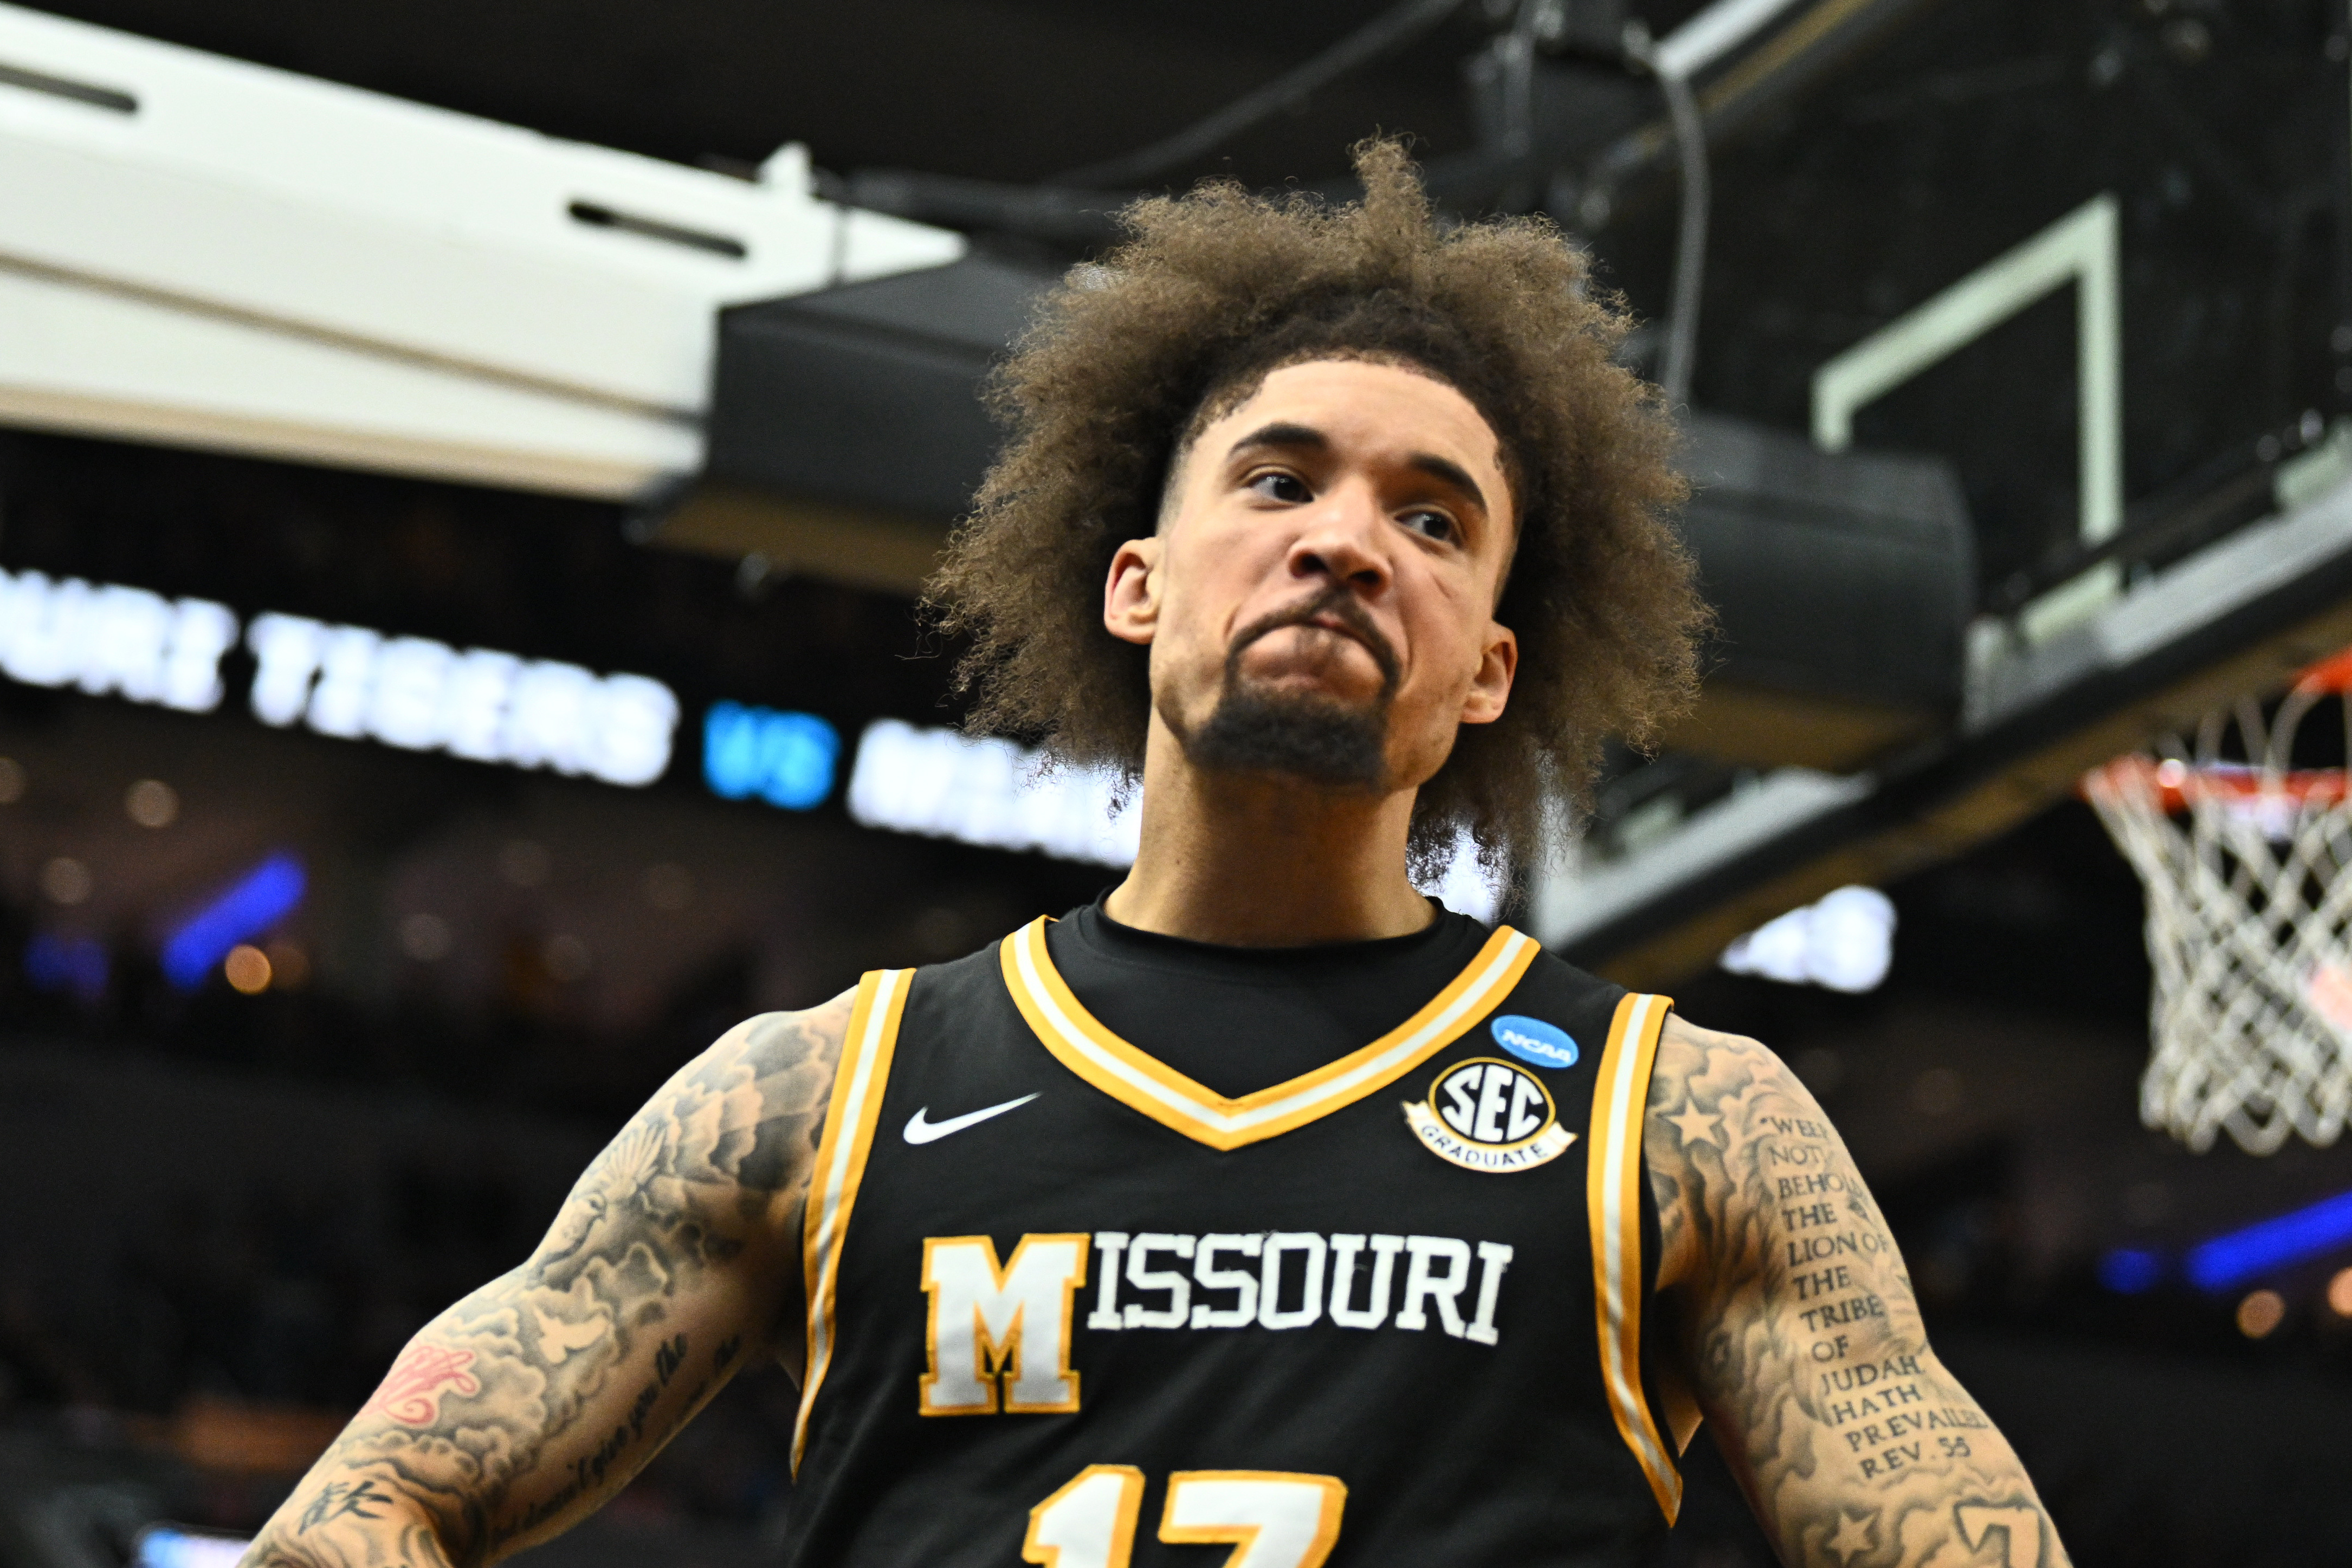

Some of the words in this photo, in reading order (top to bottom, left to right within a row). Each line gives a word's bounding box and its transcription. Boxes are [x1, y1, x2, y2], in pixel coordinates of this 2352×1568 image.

[1502, 1029, 1571, 1063] NCAA
[1441, 1064, 1544, 1143] SEC
[1421, 1125, 1549, 1167] GRADUATE
[1782, 1202, 1837, 1232] THE
[1788, 1231, 1857, 1267] LION
[1792, 1266, 1851, 1300] THE
[919, 1232, 1513, 1416] MISSOURI
[1799, 1294, 1884, 1332] TRIBE
[1811, 1335, 1849, 1363] OF
[1821, 1355, 1925, 1396] JUDAH
[1832, 1384, 1923, 1424] HATH
[1022, 1464, 1347, 1568] 17
